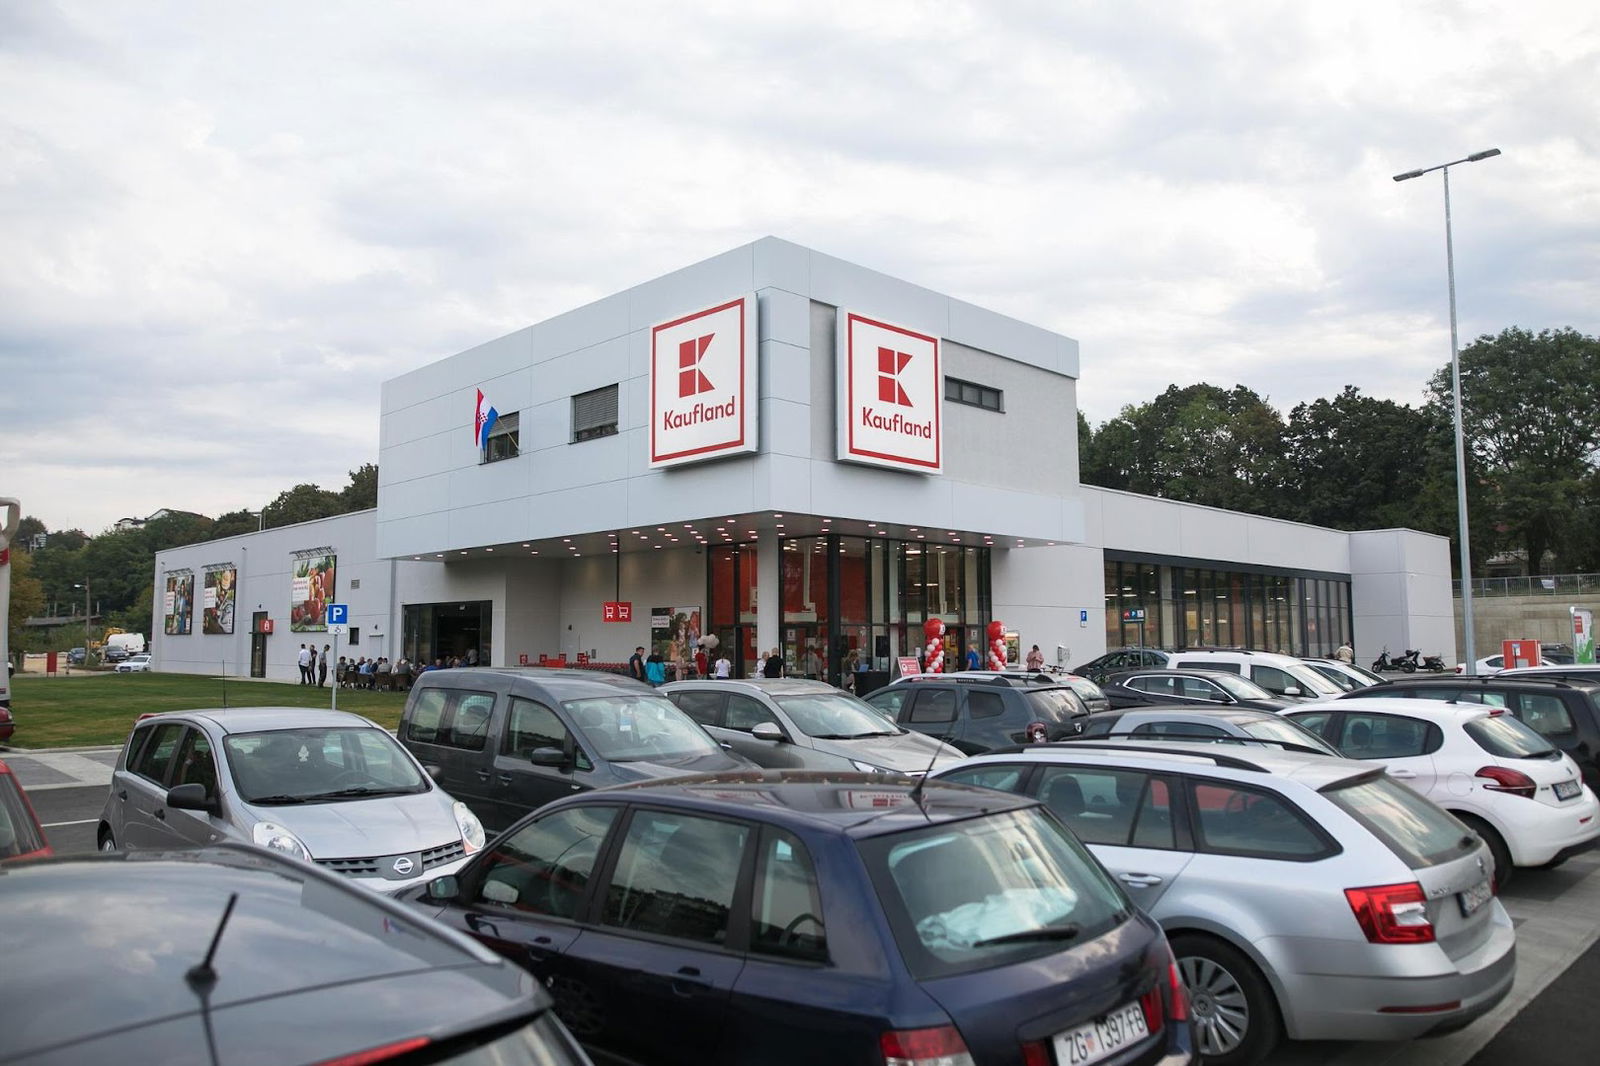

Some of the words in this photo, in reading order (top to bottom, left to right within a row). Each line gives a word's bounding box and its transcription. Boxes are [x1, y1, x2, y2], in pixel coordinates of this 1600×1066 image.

[664, 395, 735, 431] Kaufland
[862, 406, 932, 439] Kaufland
[333, 607, 343, 621] P
[1064, 1030, 1088, 1064] ZG
